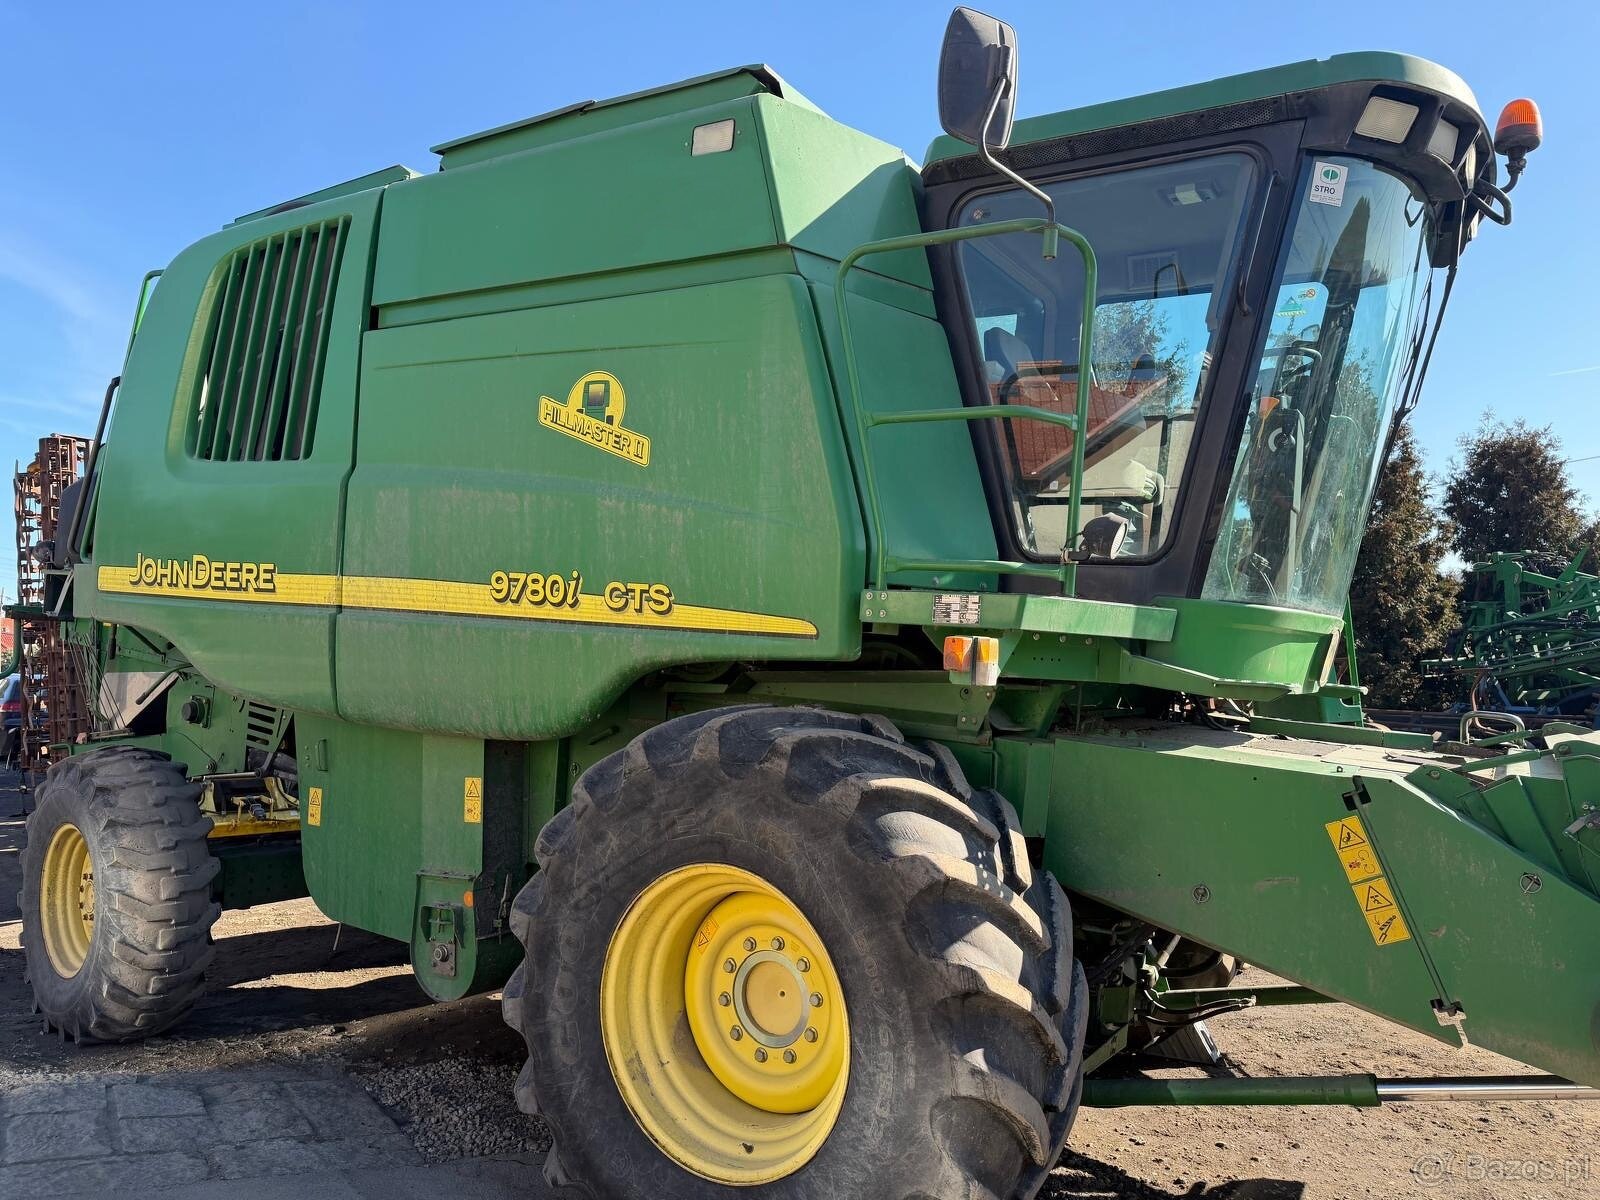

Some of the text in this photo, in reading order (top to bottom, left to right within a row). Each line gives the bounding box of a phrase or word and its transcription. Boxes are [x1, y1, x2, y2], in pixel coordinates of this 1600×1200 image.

[1314, 184, 1336, 195] STRO
[543, 402, 631, 455] HILLMASTER
[129, 552, 277, 593] JOHN DEERE
[489, 568, 583, 610] 9780i
